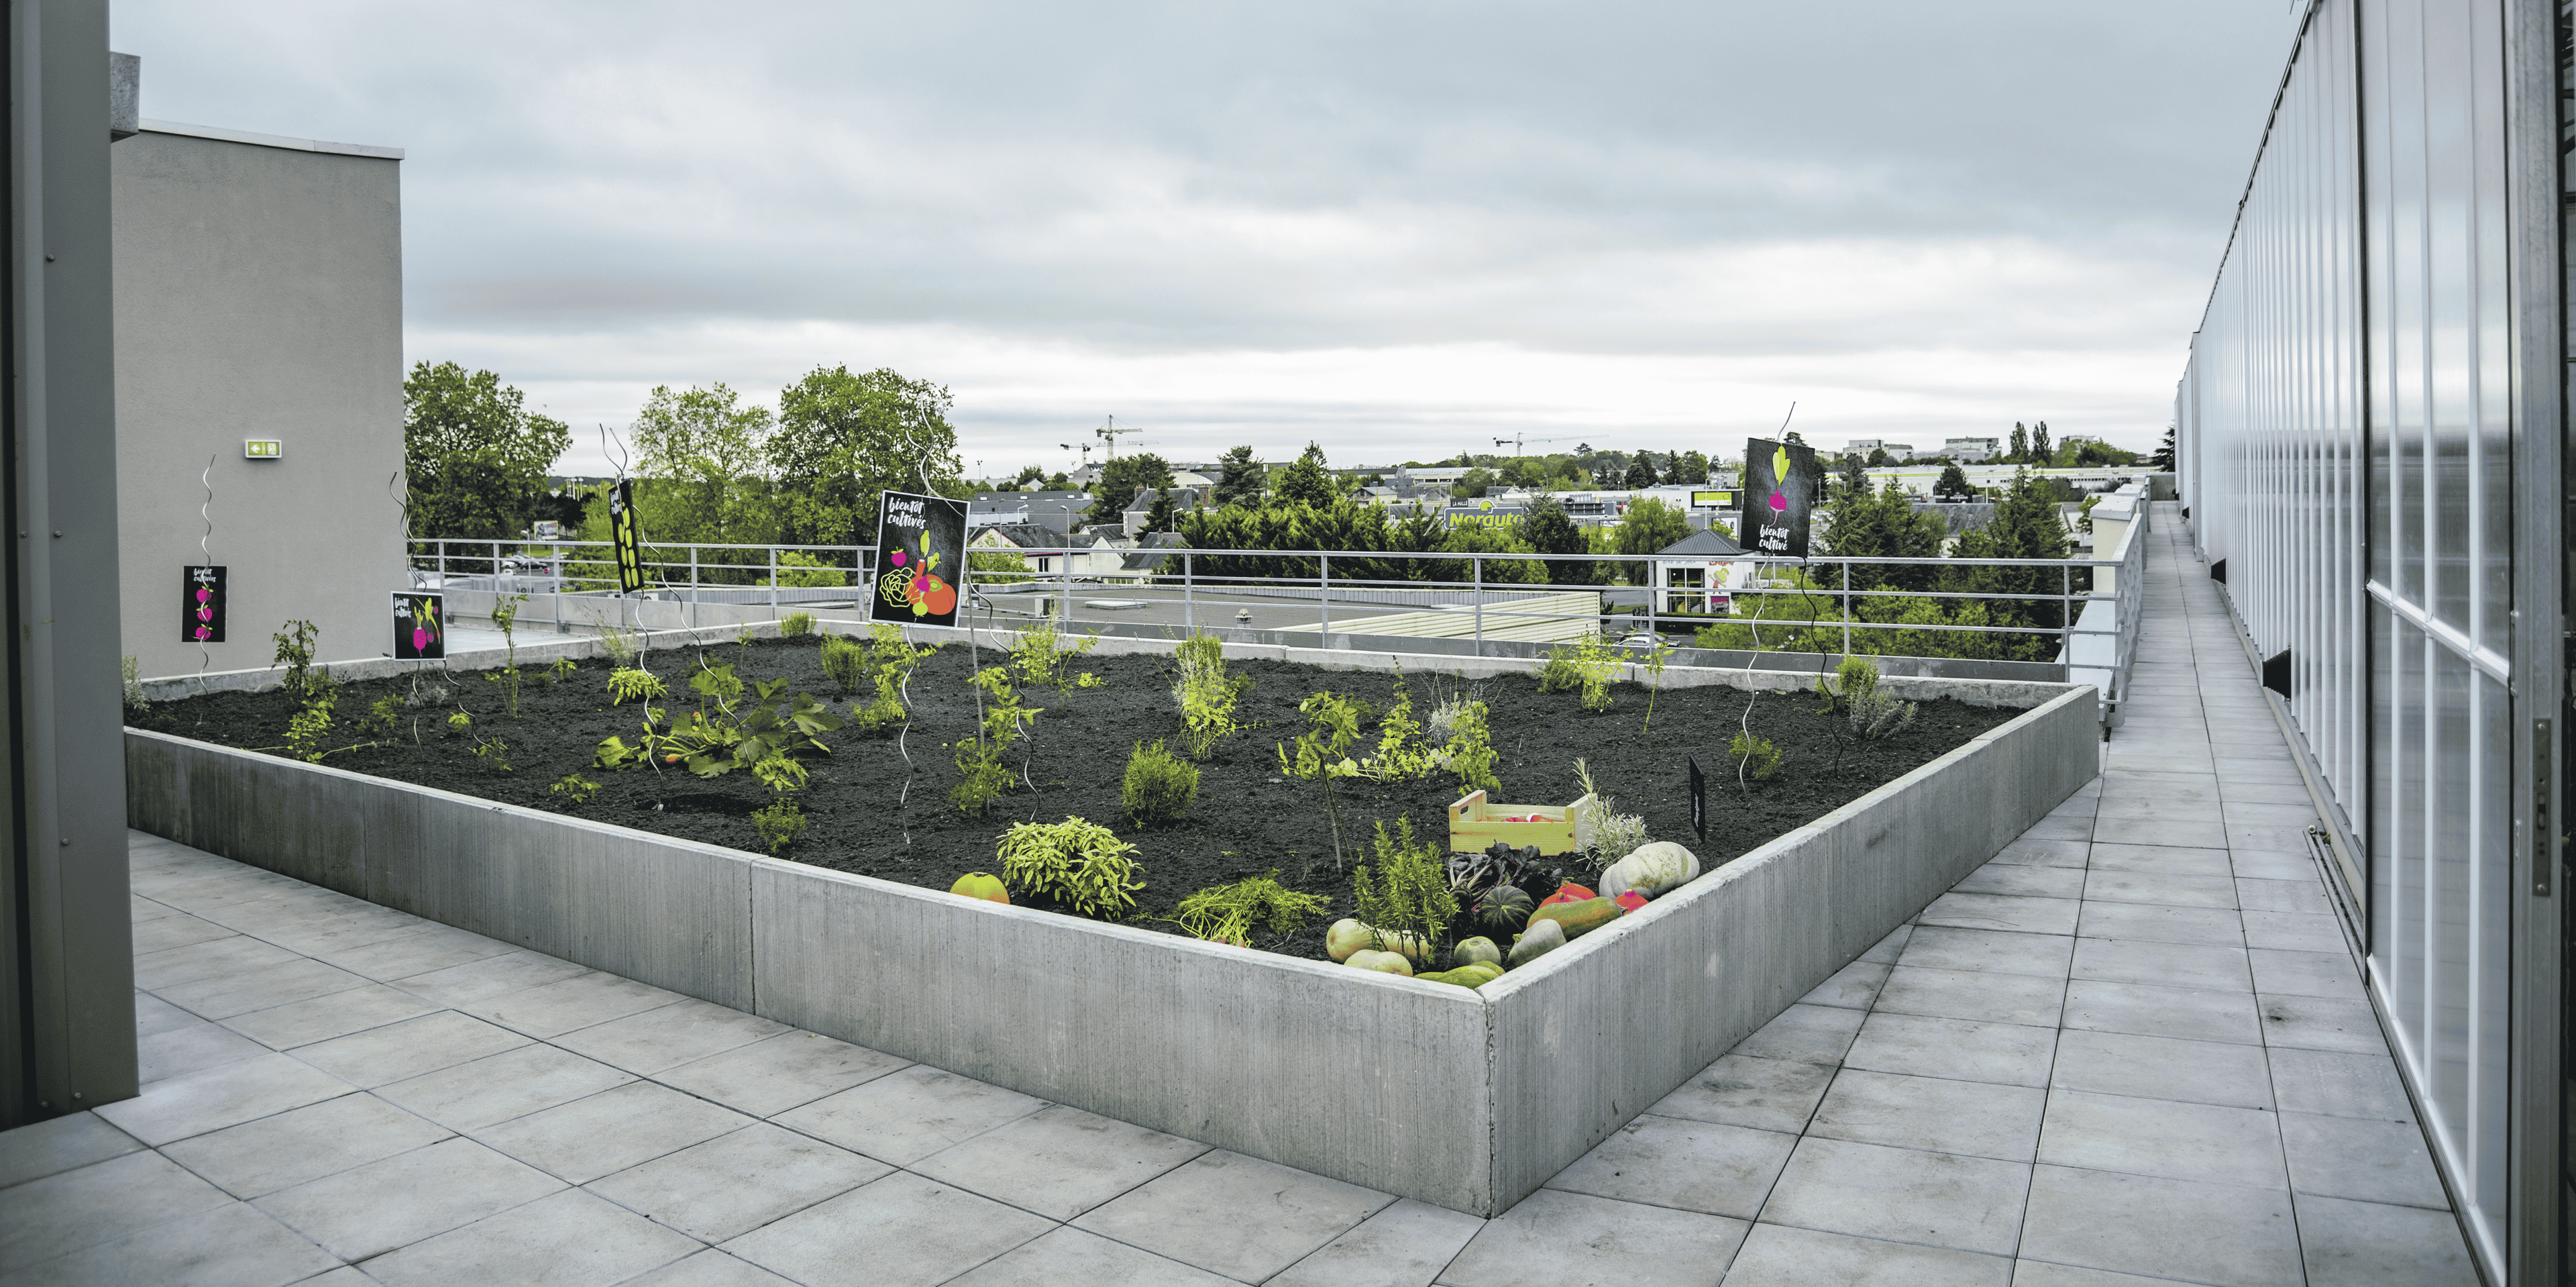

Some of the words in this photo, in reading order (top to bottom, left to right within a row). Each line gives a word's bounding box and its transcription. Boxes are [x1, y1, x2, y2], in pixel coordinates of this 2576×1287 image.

[889, 497, 924, 515] bientôt
[888, 511, 926, 529] cultivés
[1449, 512, 1525, 527] Norauto
[1760, 523, 1789, 539] bientôt
[1759, 536, 1788, 550] cultivé
